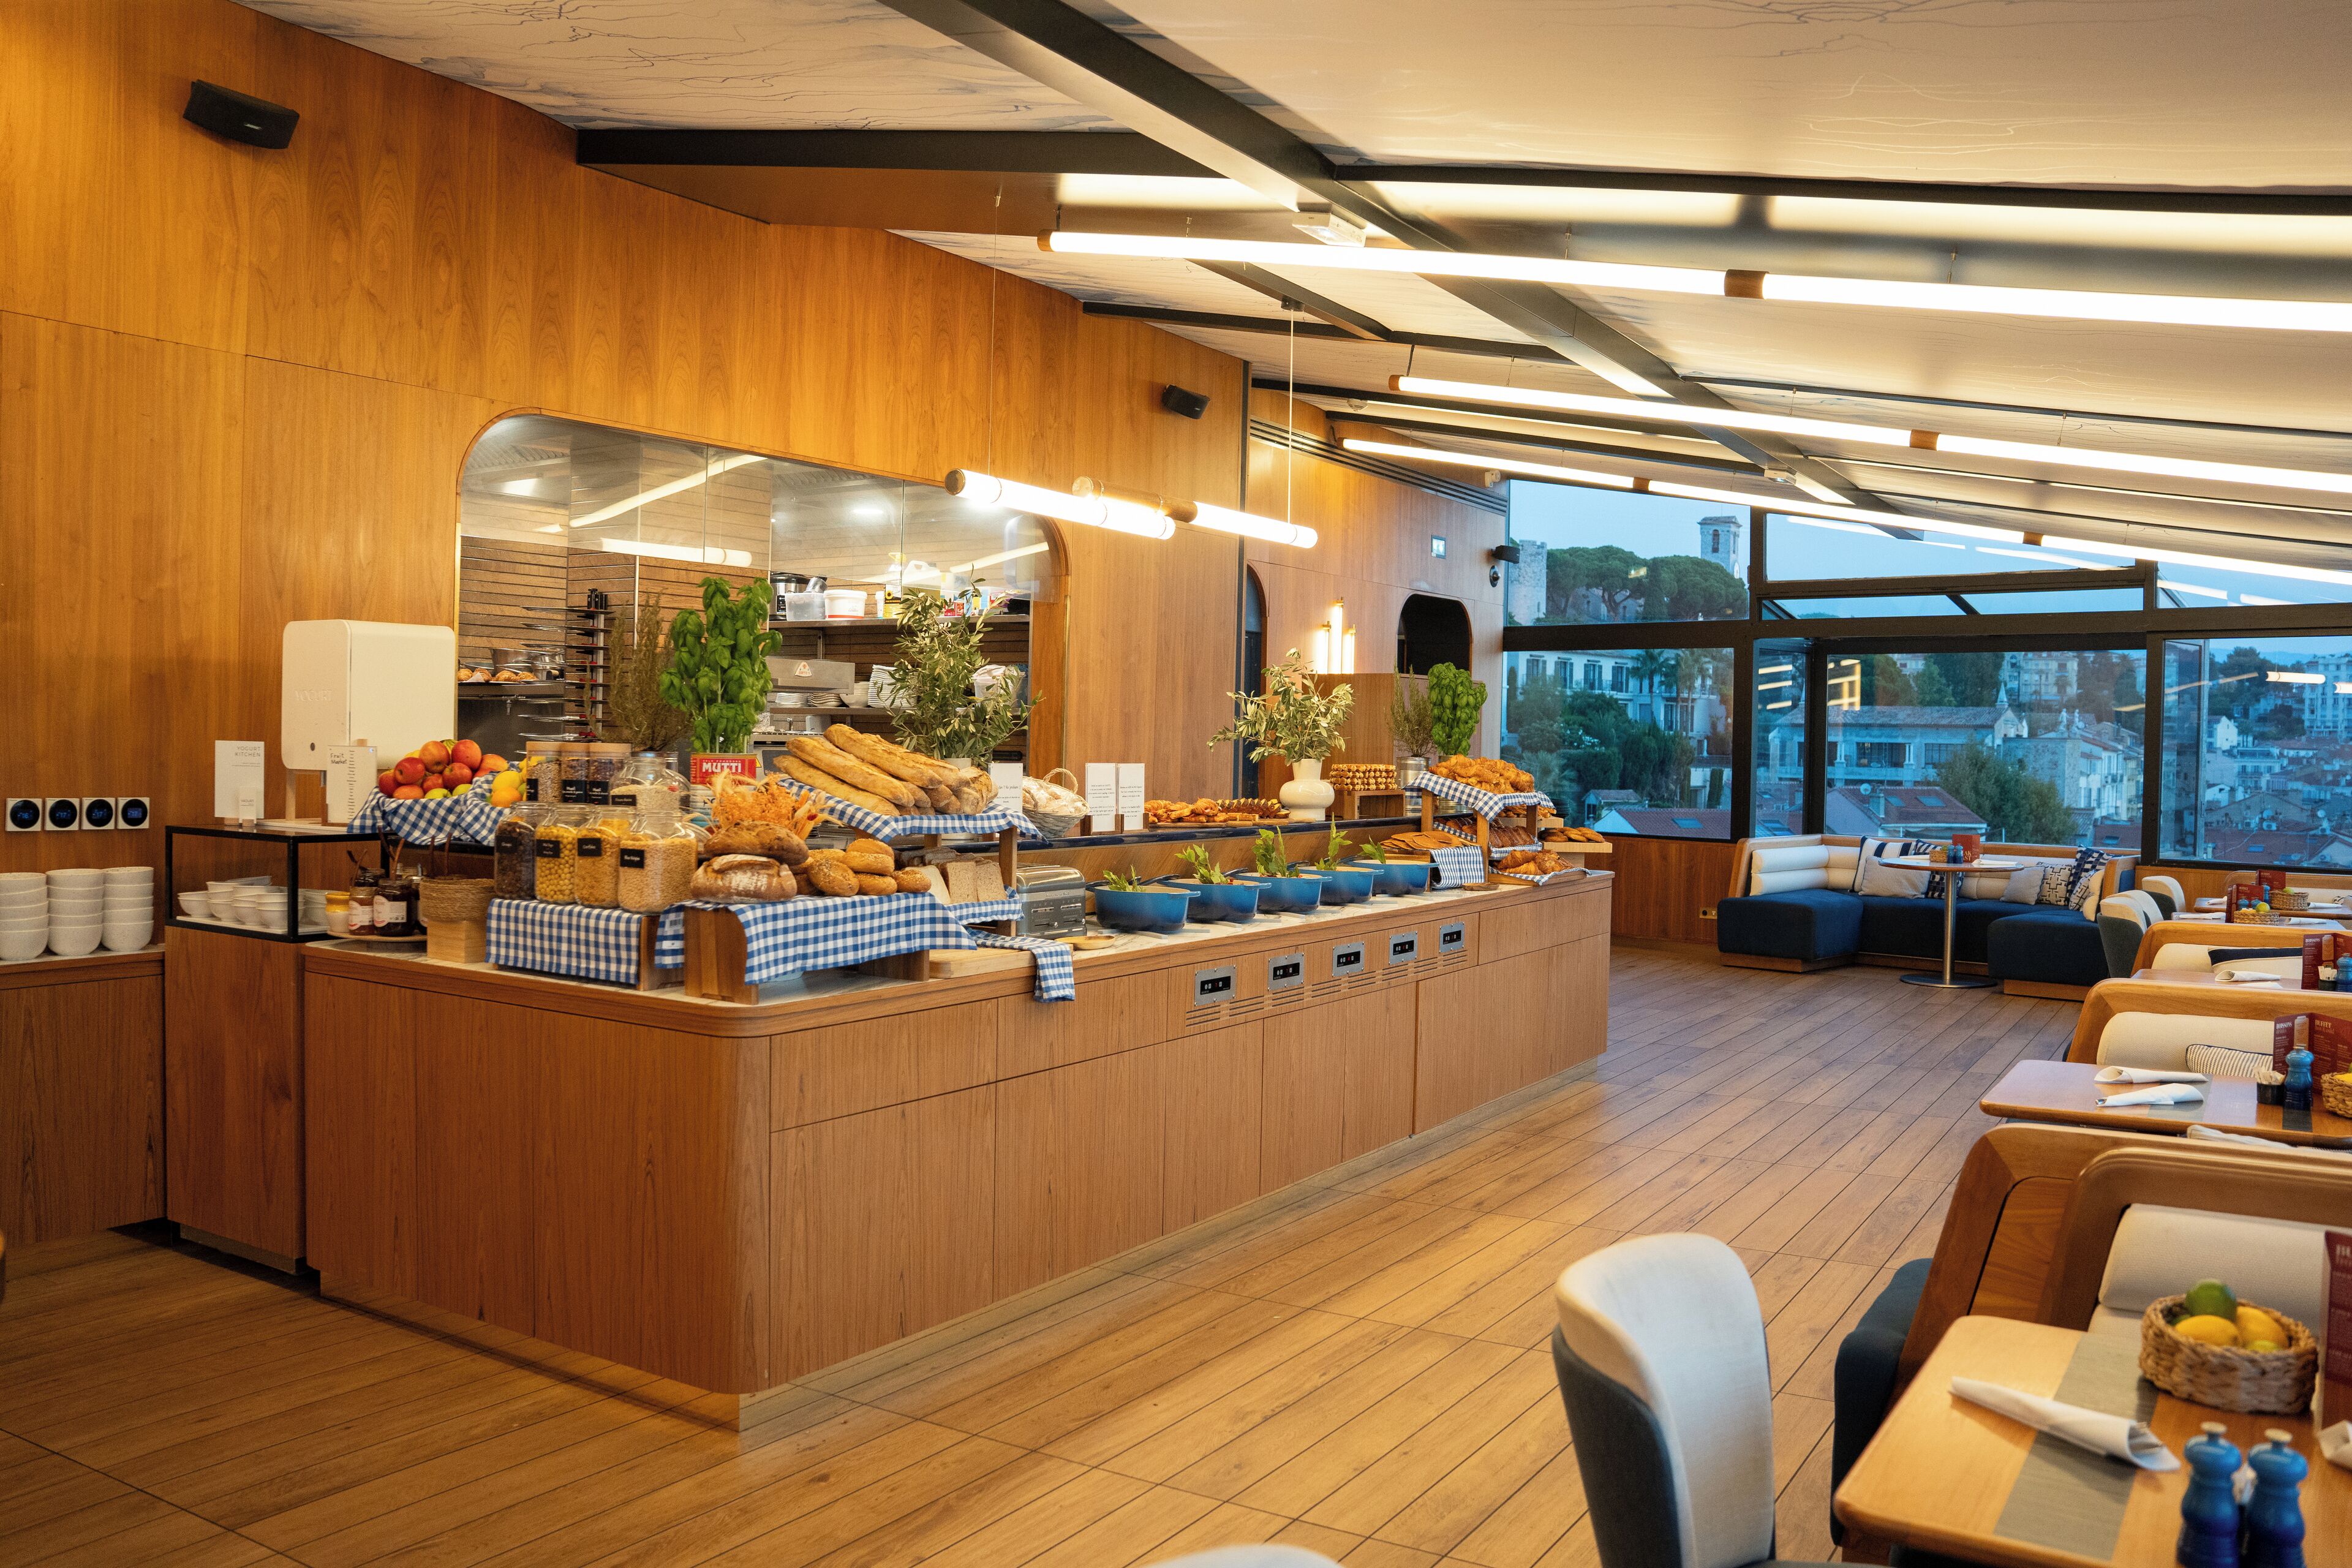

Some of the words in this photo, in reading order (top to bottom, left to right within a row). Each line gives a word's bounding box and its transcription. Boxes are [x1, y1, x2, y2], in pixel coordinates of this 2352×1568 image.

[294, 688, 334, 701] YOGURT
[702, 762, 742, 773] MUTTI
[2315, 1020, 2332, 1029] BUFFET
